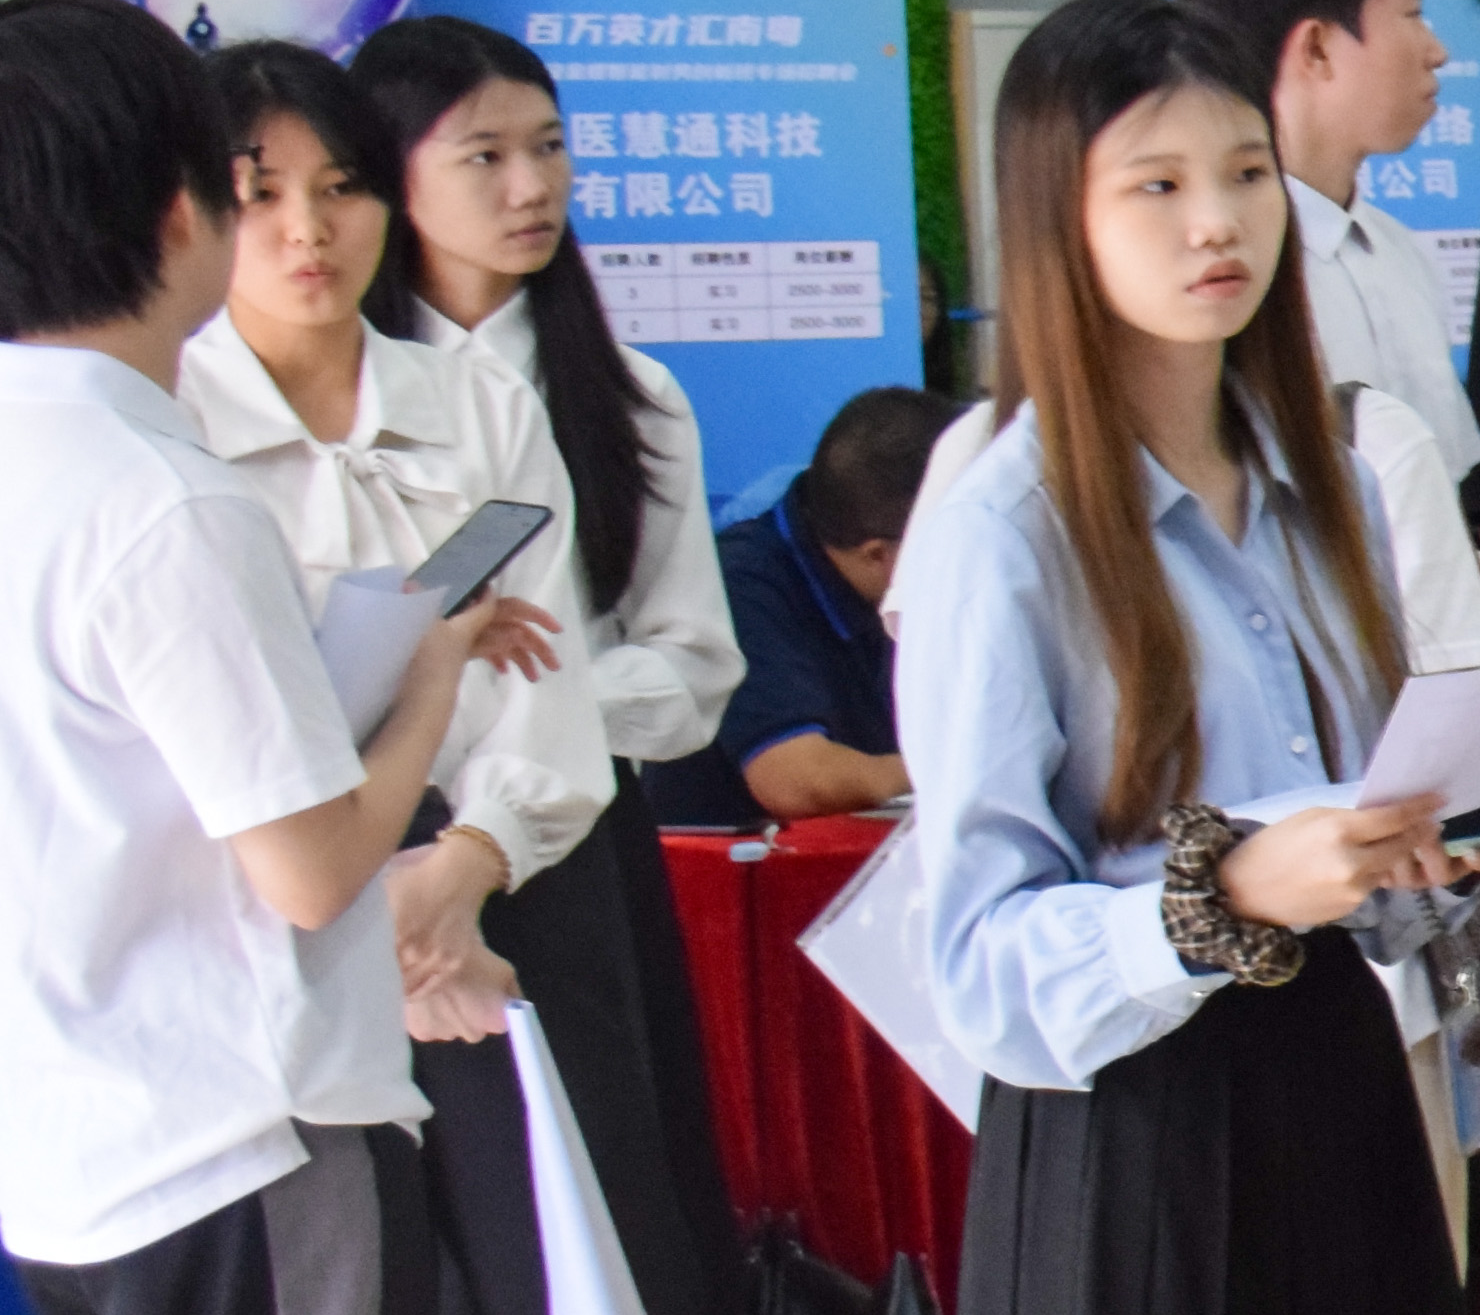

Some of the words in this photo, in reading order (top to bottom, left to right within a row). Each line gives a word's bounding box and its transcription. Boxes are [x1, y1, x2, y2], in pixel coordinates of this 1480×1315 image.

[527, 12, 805, 48] 百万英才汇南粤
[573, 171, 774, 219] 有限公司
